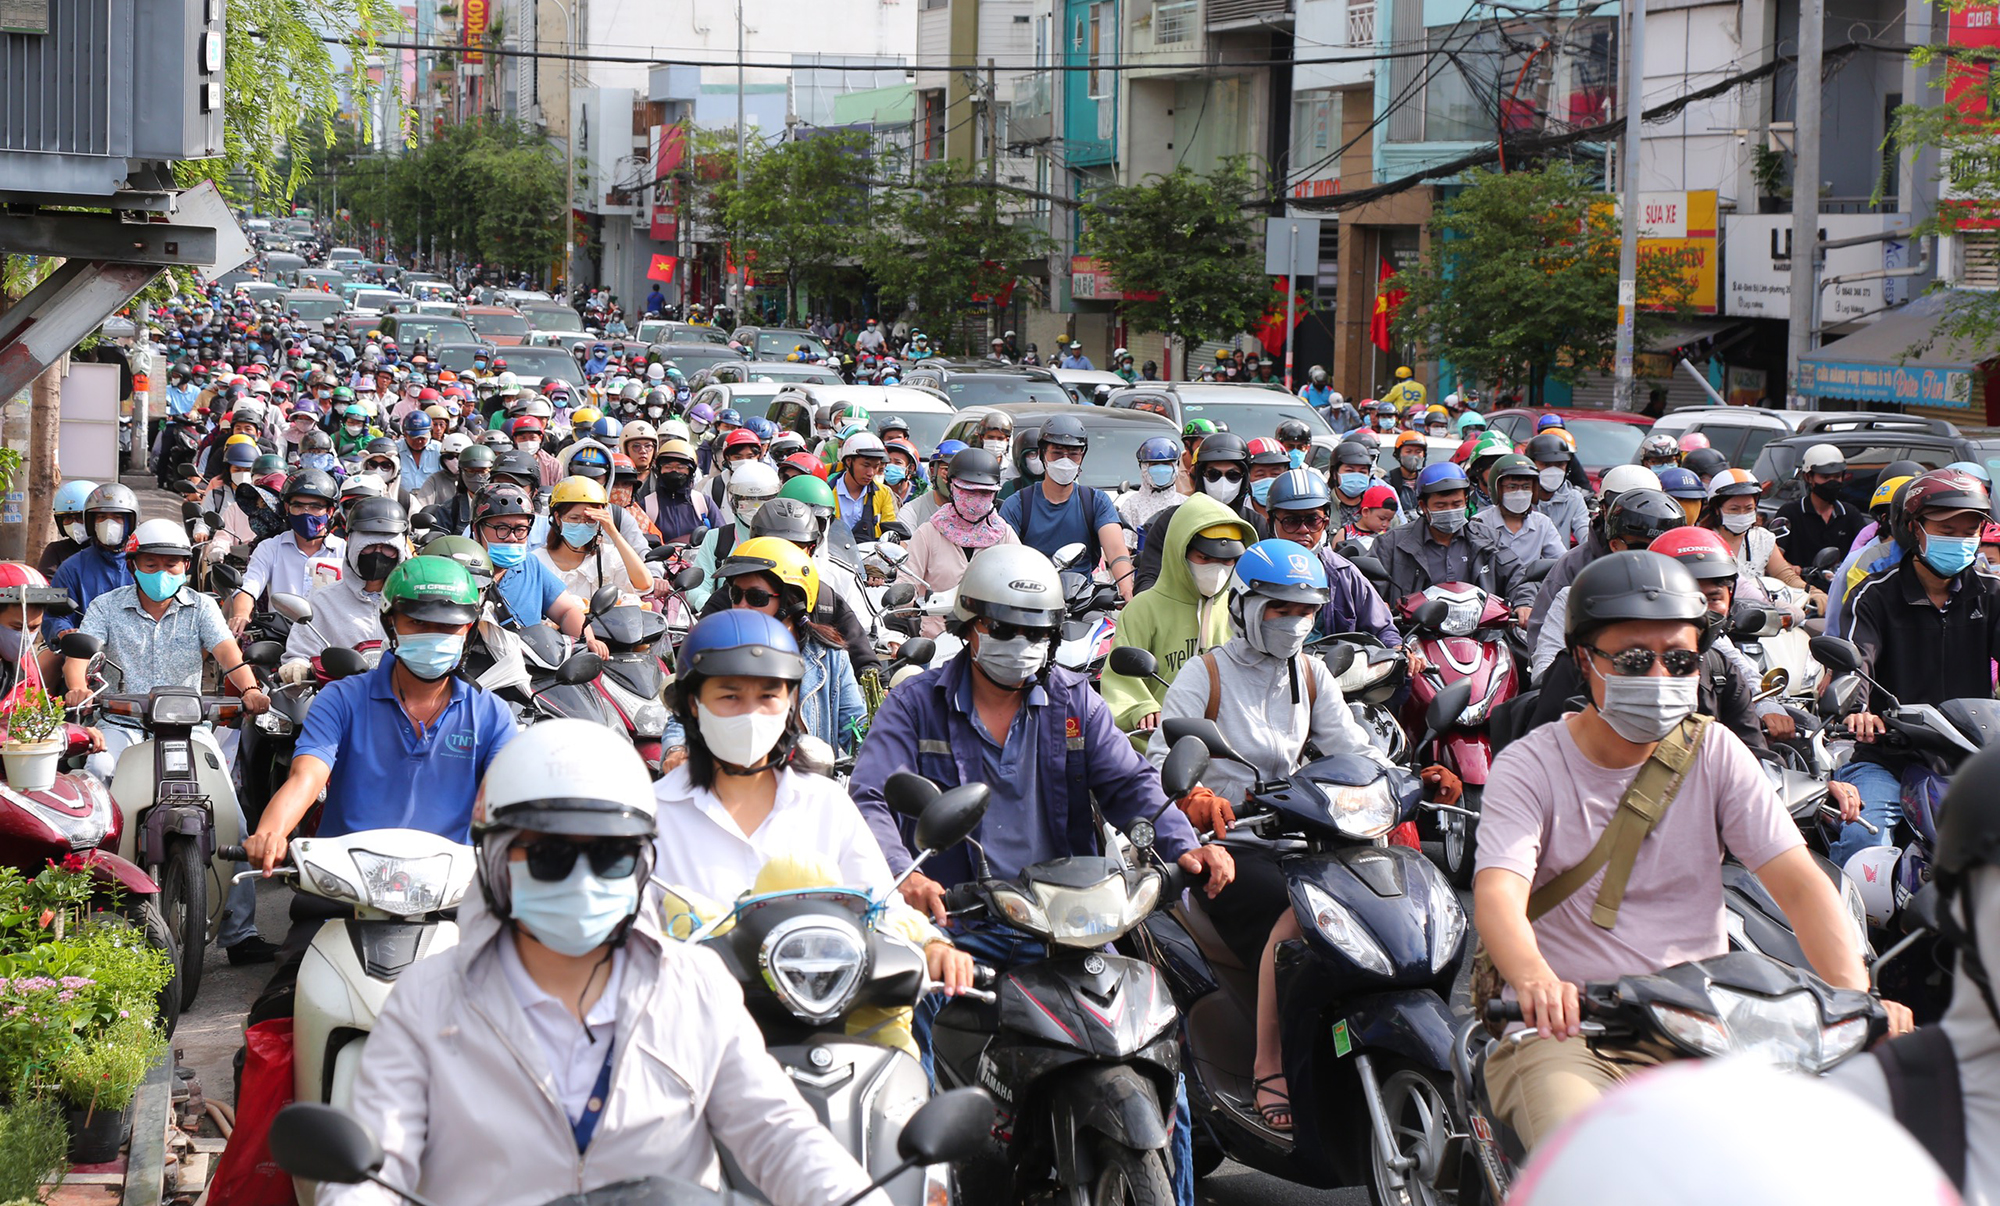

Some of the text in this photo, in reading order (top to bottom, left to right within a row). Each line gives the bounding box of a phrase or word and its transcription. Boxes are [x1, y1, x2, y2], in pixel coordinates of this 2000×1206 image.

[1666, 204, 1676, 224] XE
[1402, 386, 1422, 402] be
[1681, 476, 1695, 485] ila
[1014, 582, 1043, 590] HJC
